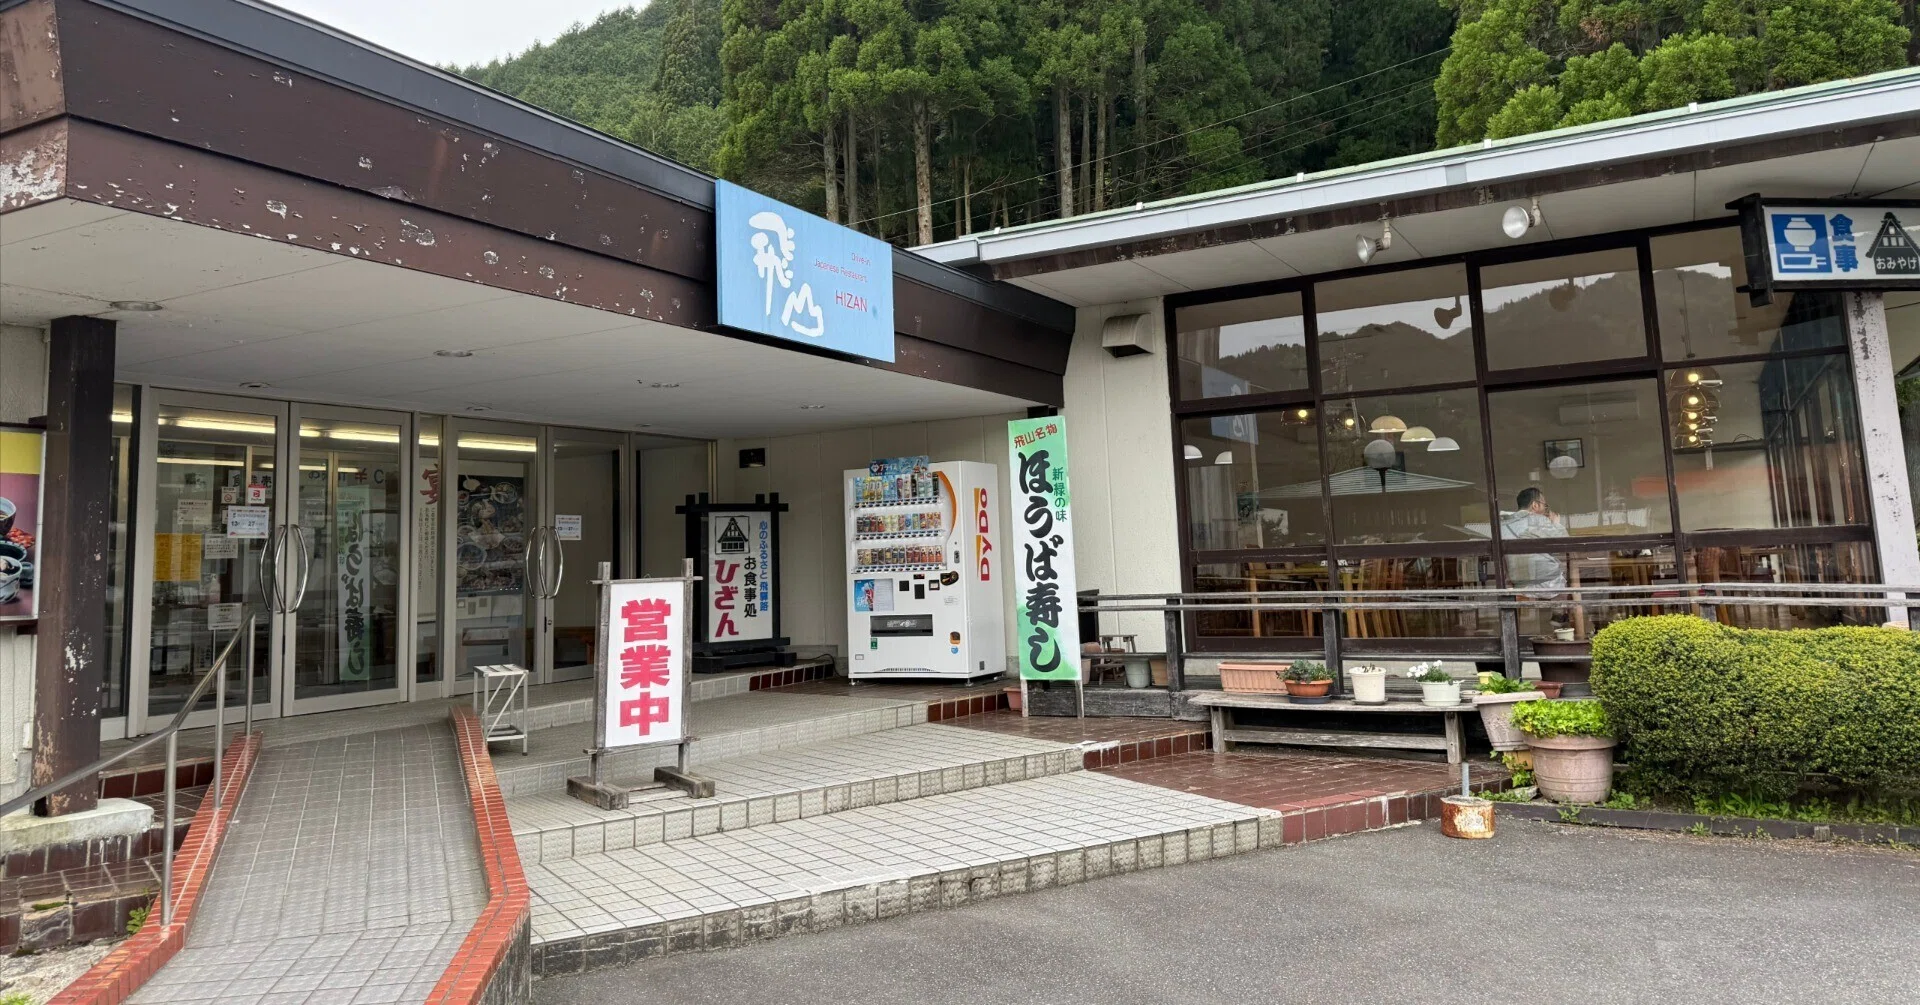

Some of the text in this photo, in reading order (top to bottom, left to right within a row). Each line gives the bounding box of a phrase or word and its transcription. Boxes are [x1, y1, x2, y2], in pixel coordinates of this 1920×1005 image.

[1829, 213, 1859, 272] 食事
[1875, 256, 1918, 271] おみやげ
[835, 289, 868, 313] HIZAN
[1014, 423, 1058, 448] 飛山名物
[1052, 466, 1067, 522] 新緑の味
[743, 556, 757, 618] お食事処
[1018, 450, 1064, 673] ほうば寿し
[714, 559, 740, 638] ひざん
[619, 597, 671, 737] 営業中
